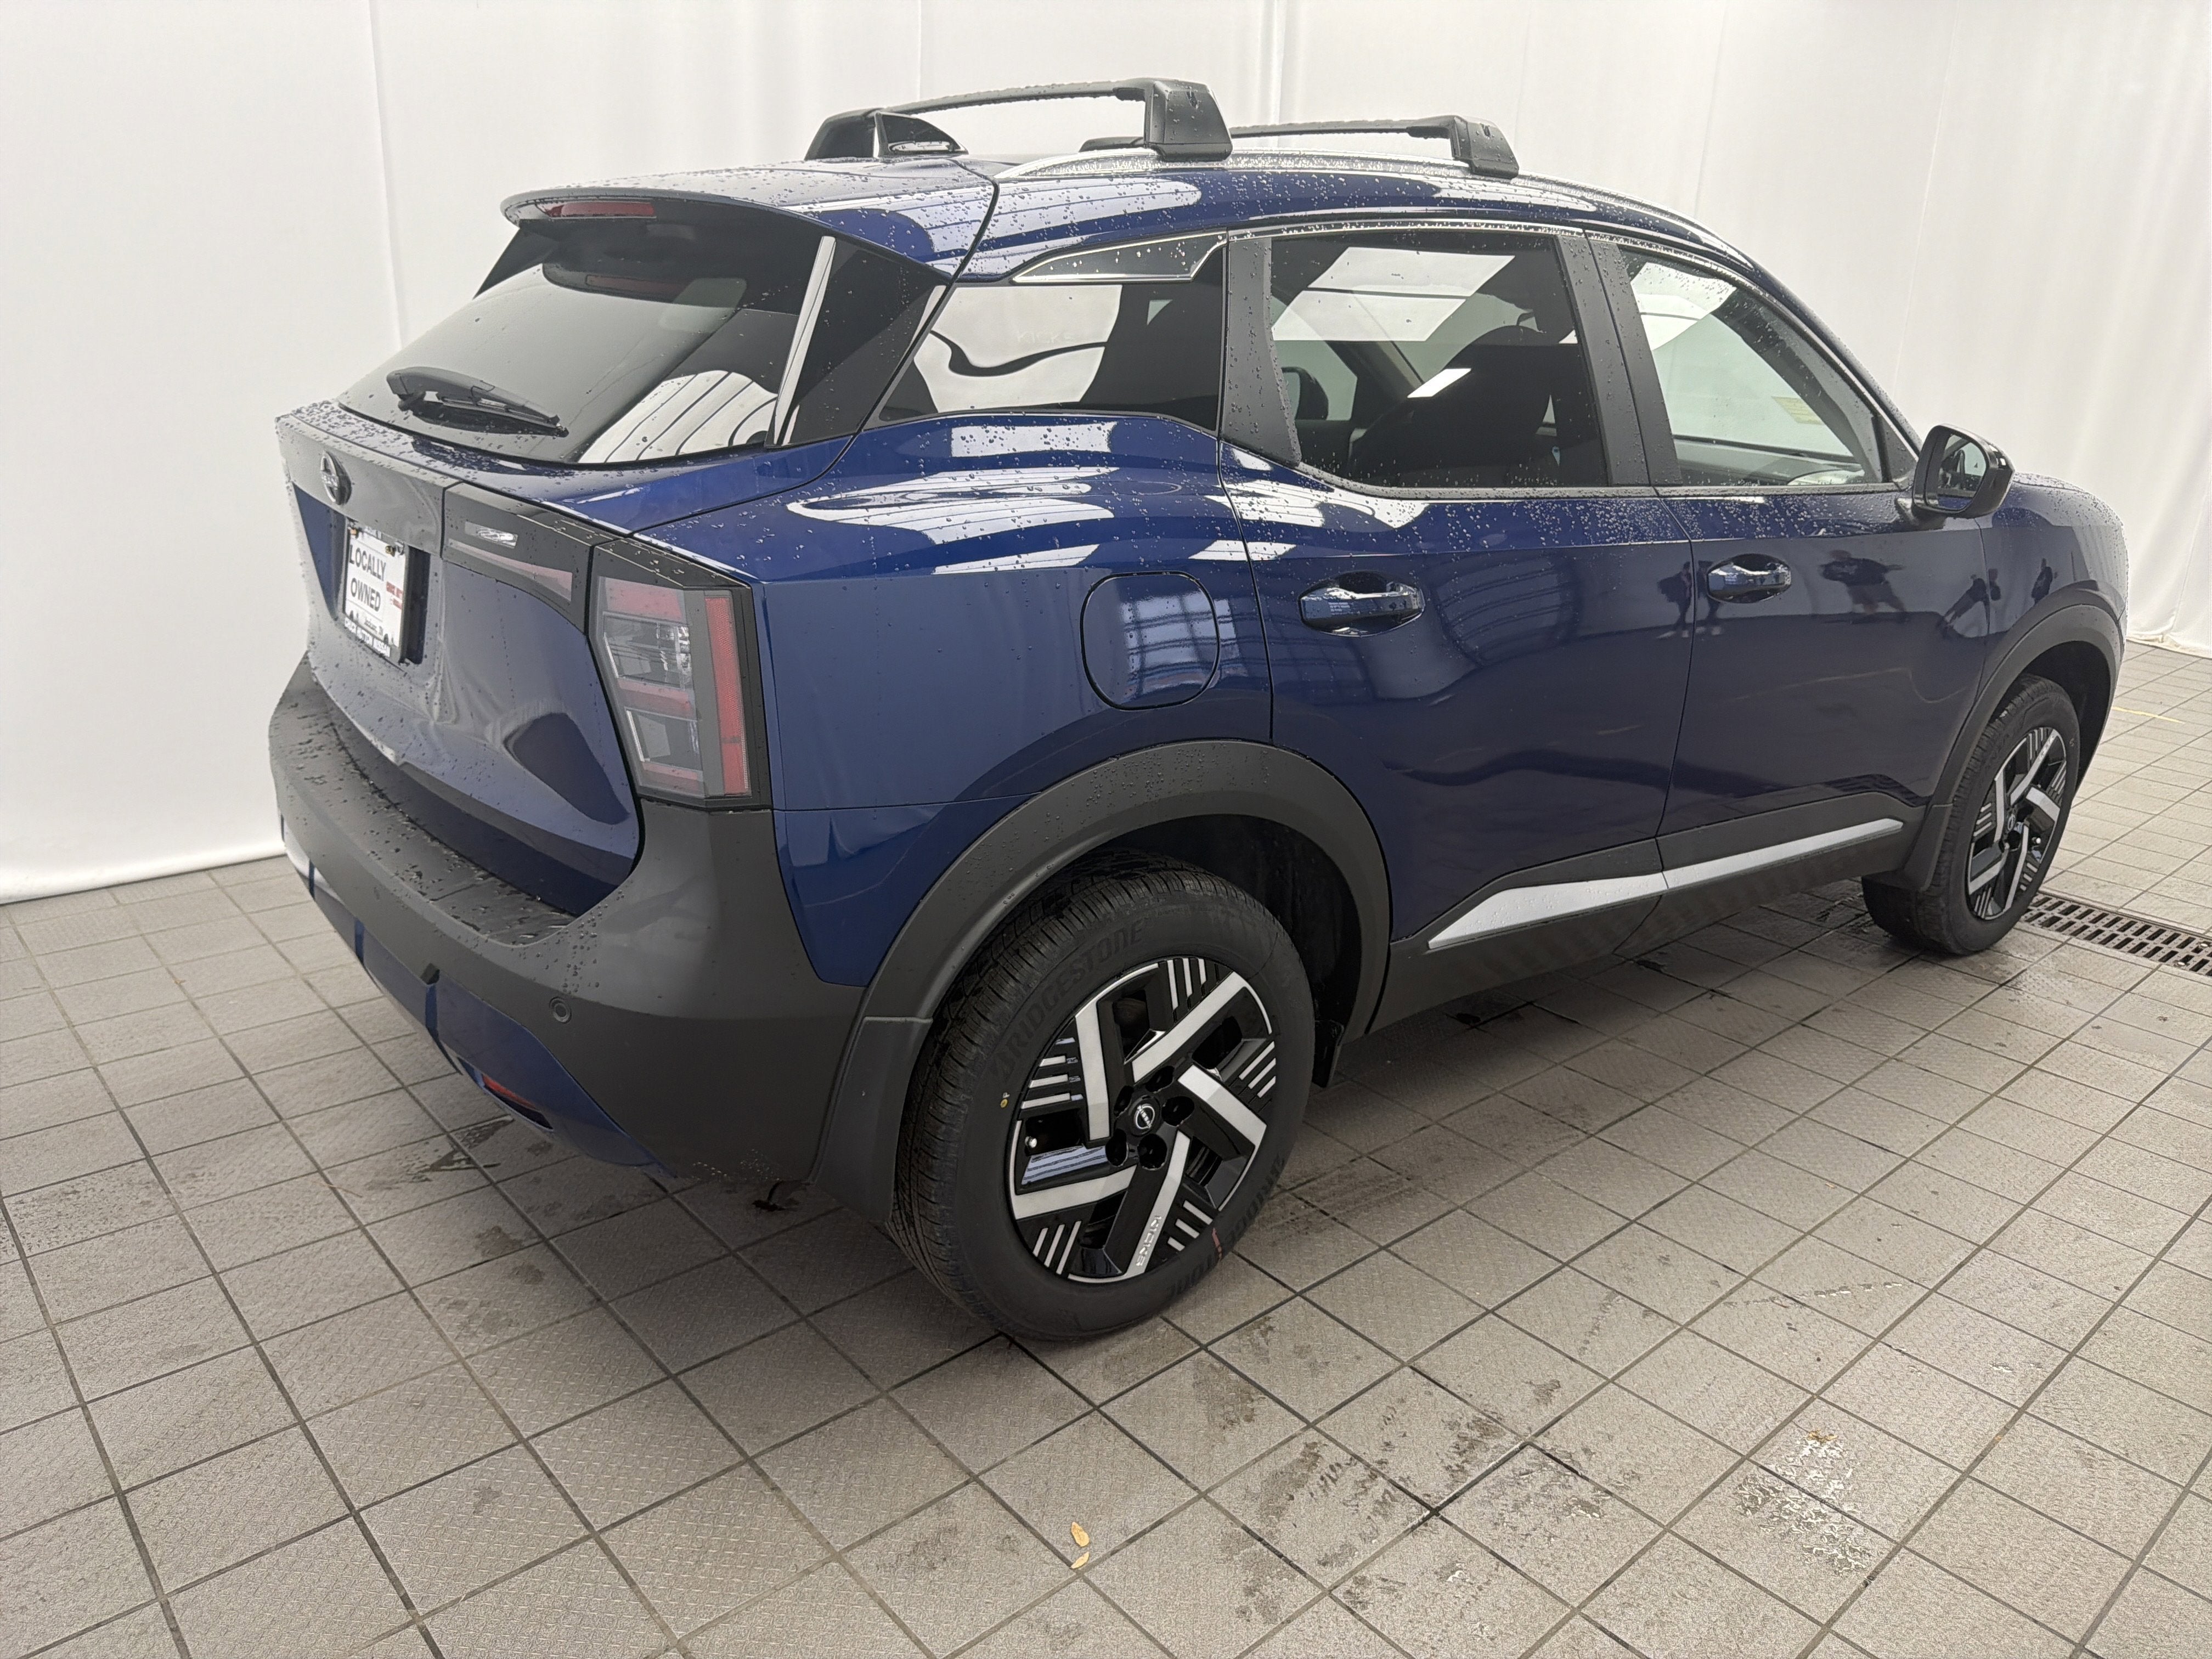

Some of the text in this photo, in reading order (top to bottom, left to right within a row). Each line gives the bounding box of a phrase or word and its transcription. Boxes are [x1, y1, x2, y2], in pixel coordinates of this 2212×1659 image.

[349, 544, 386, 582] LOCALLY
[351, 578, 381, 612] OWNED
[1136, 1216, 1162, 1266] KICKS
